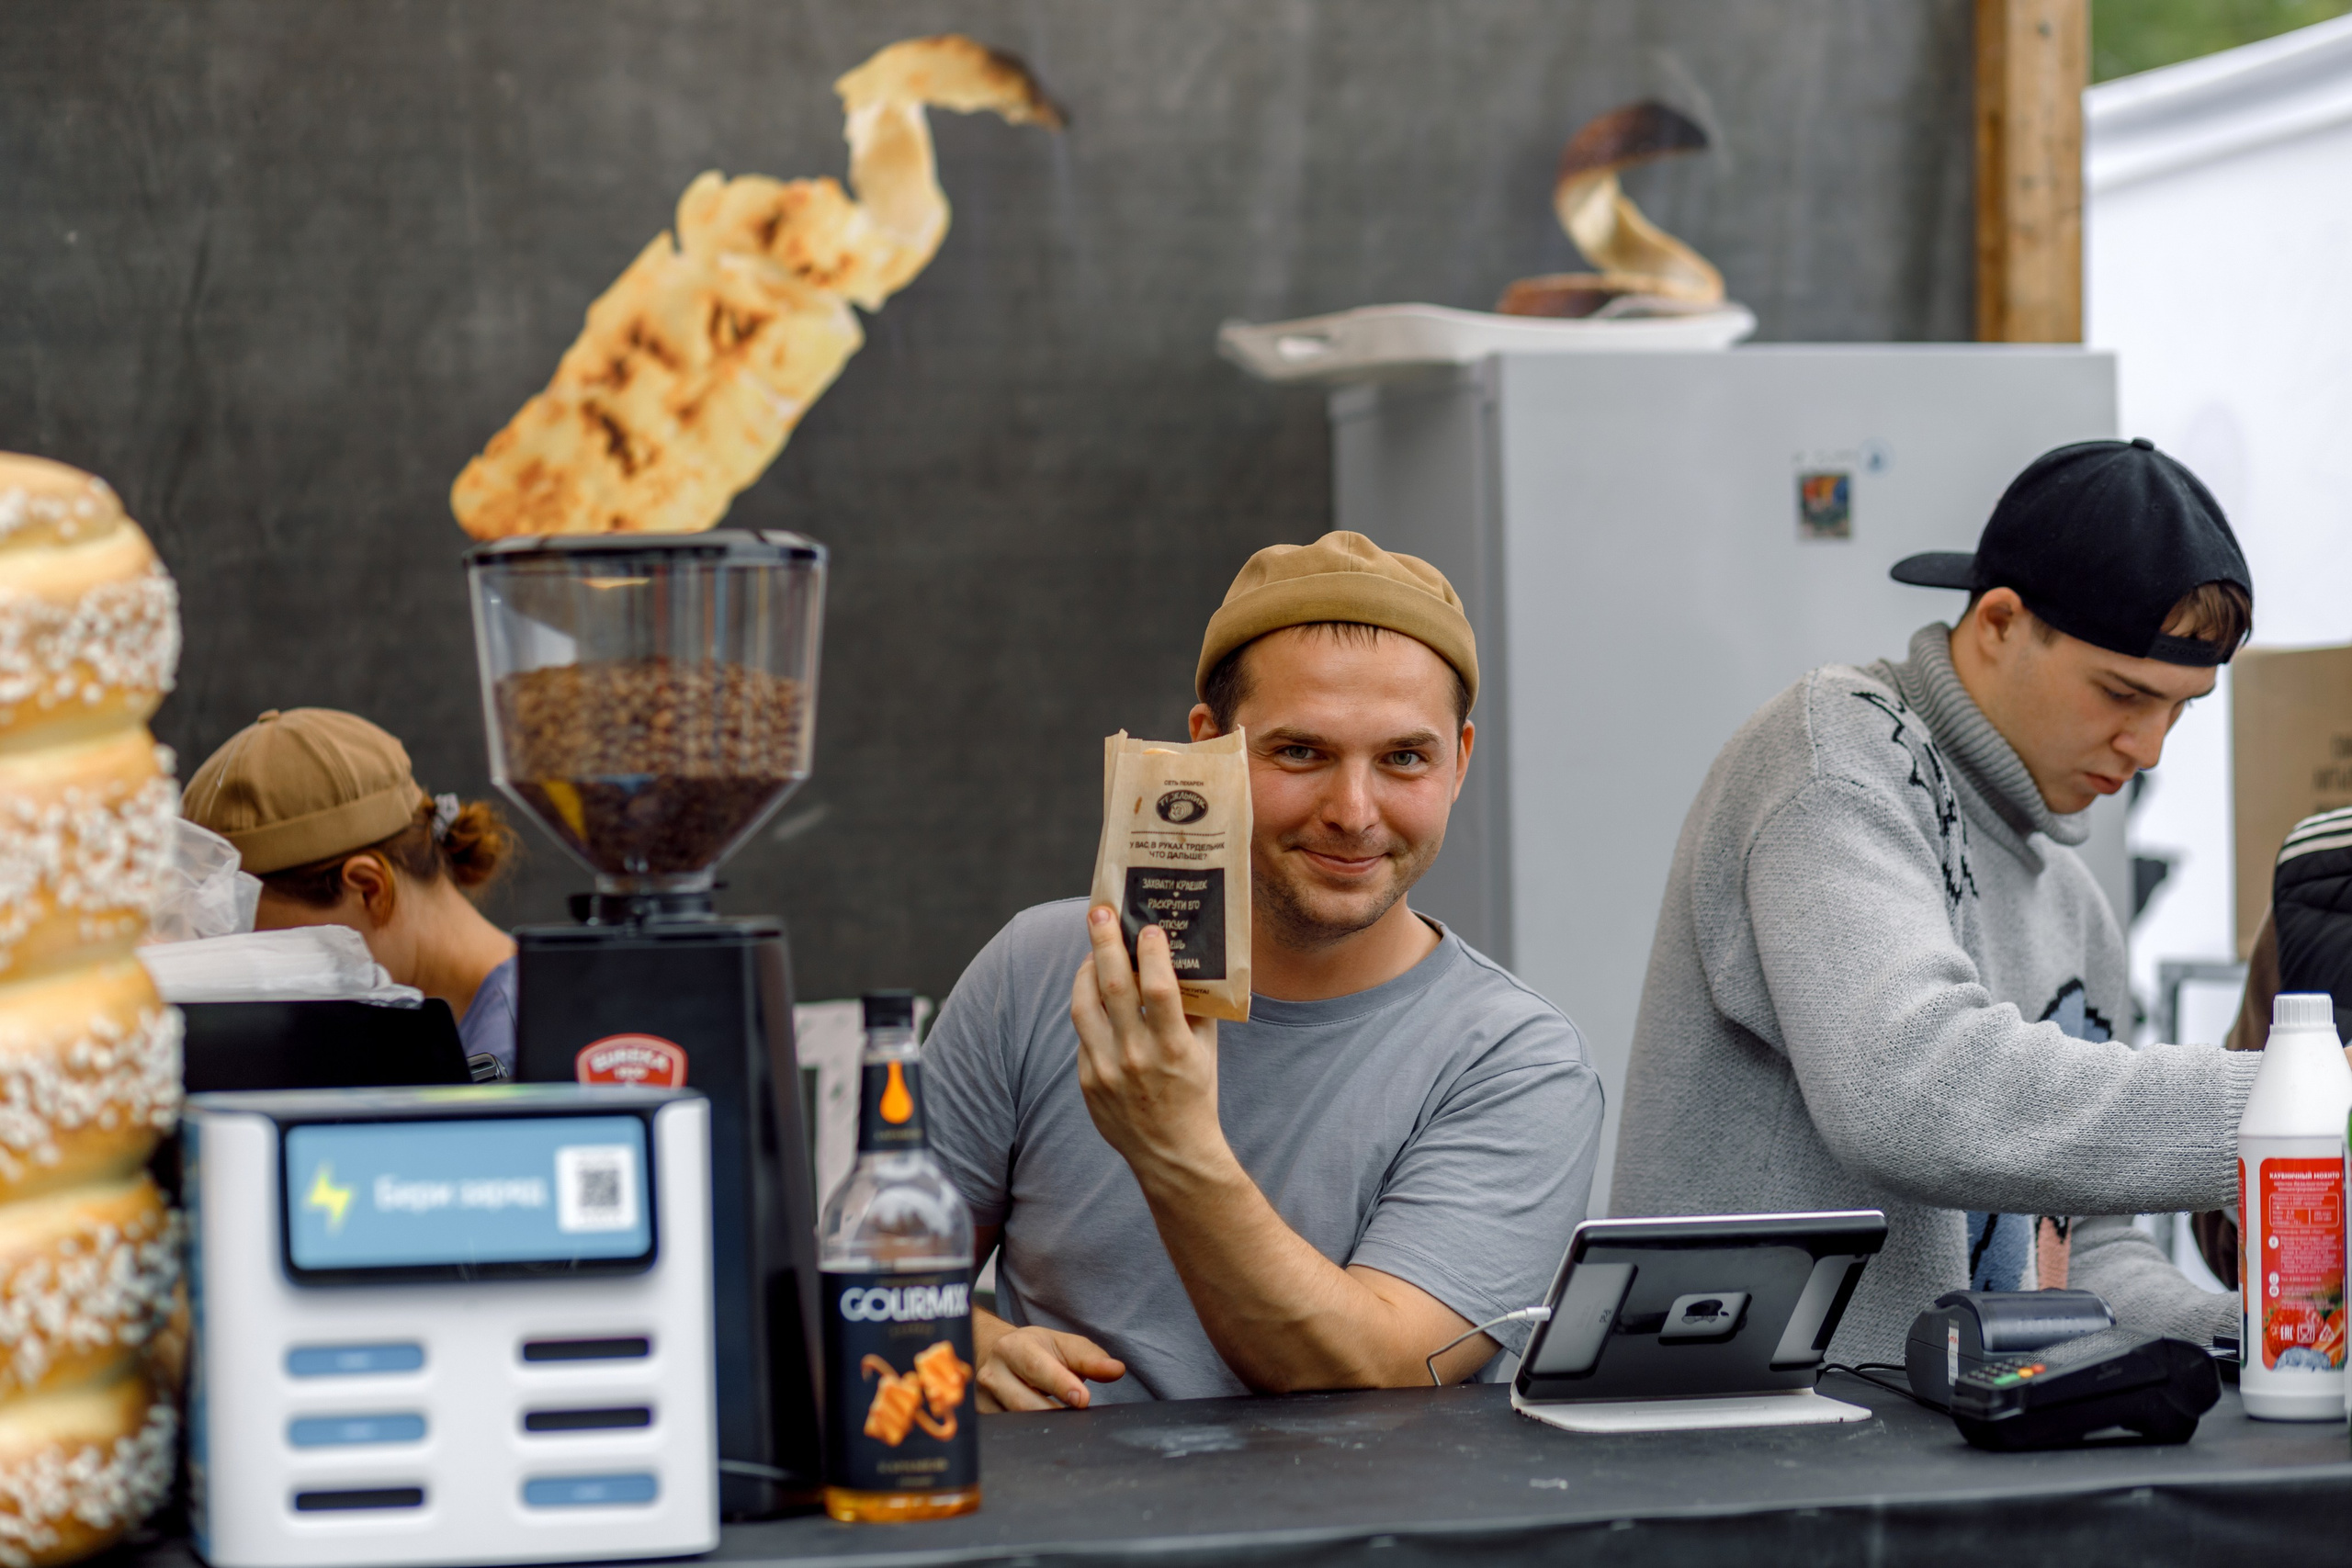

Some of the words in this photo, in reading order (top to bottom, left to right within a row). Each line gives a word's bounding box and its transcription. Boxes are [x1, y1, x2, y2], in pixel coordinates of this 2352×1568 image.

[1159, 842, 1183, 851] РУКАХ
[1149, 851, 1166, 859] ЧТО
[1167, 852, 1208, 860] ДАЛЬШЕ?
[1142, 878, 1174, 889] ЗАХВАТИ
[1175, 879, 1208, 891] КРАЕШЕК
[1148, 898, 1187, 910] РАСКРУТИ
[1188, 899, 1201, 910] ЕГО
[1159, 919, 1189, 931] ОТКУСИ
[840, 1282, 970, 1322] GOURMIX
